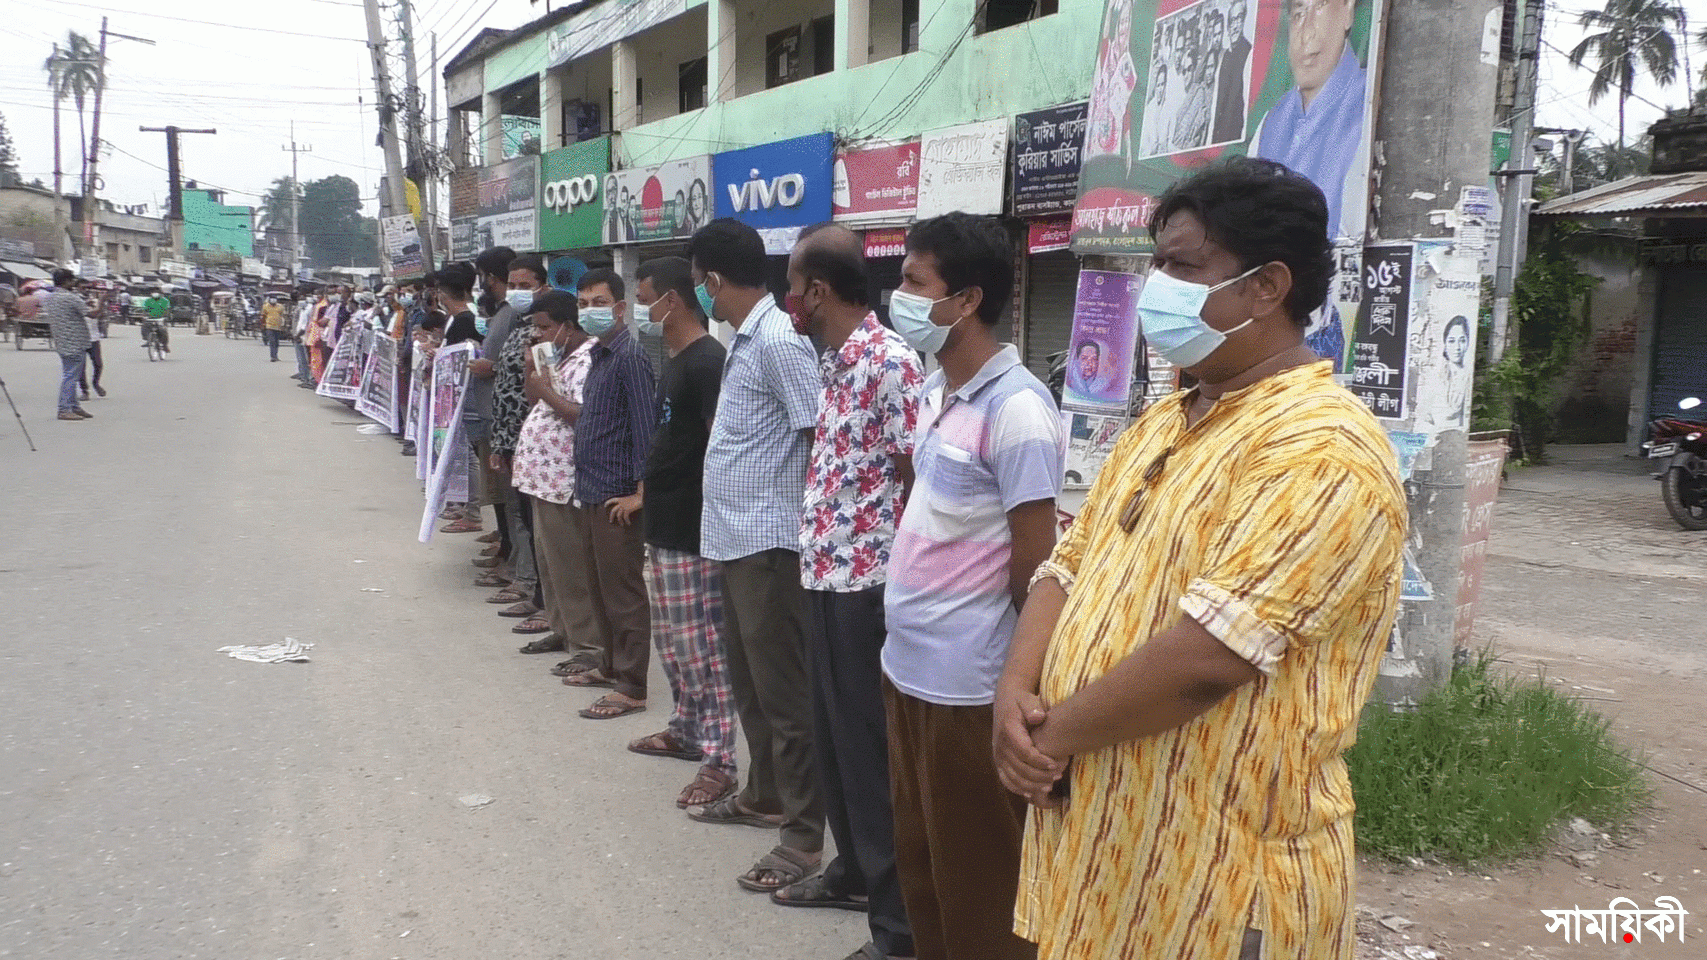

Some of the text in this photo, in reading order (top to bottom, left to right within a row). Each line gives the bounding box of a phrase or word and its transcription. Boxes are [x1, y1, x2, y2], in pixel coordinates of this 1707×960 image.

[1033, 120, 1057, 145] নাঈম
[1017, 147, 1048, 177] কুরিয়ার
[1050, 140, 1079, 168] সার্ভিস
[544, 174, 598, 215] oppo
[727, 168, 805, 213] vivo
[1367, 260, 1402, 289] ১৫ই
[1377, 392, 1400, 413] লীগ
